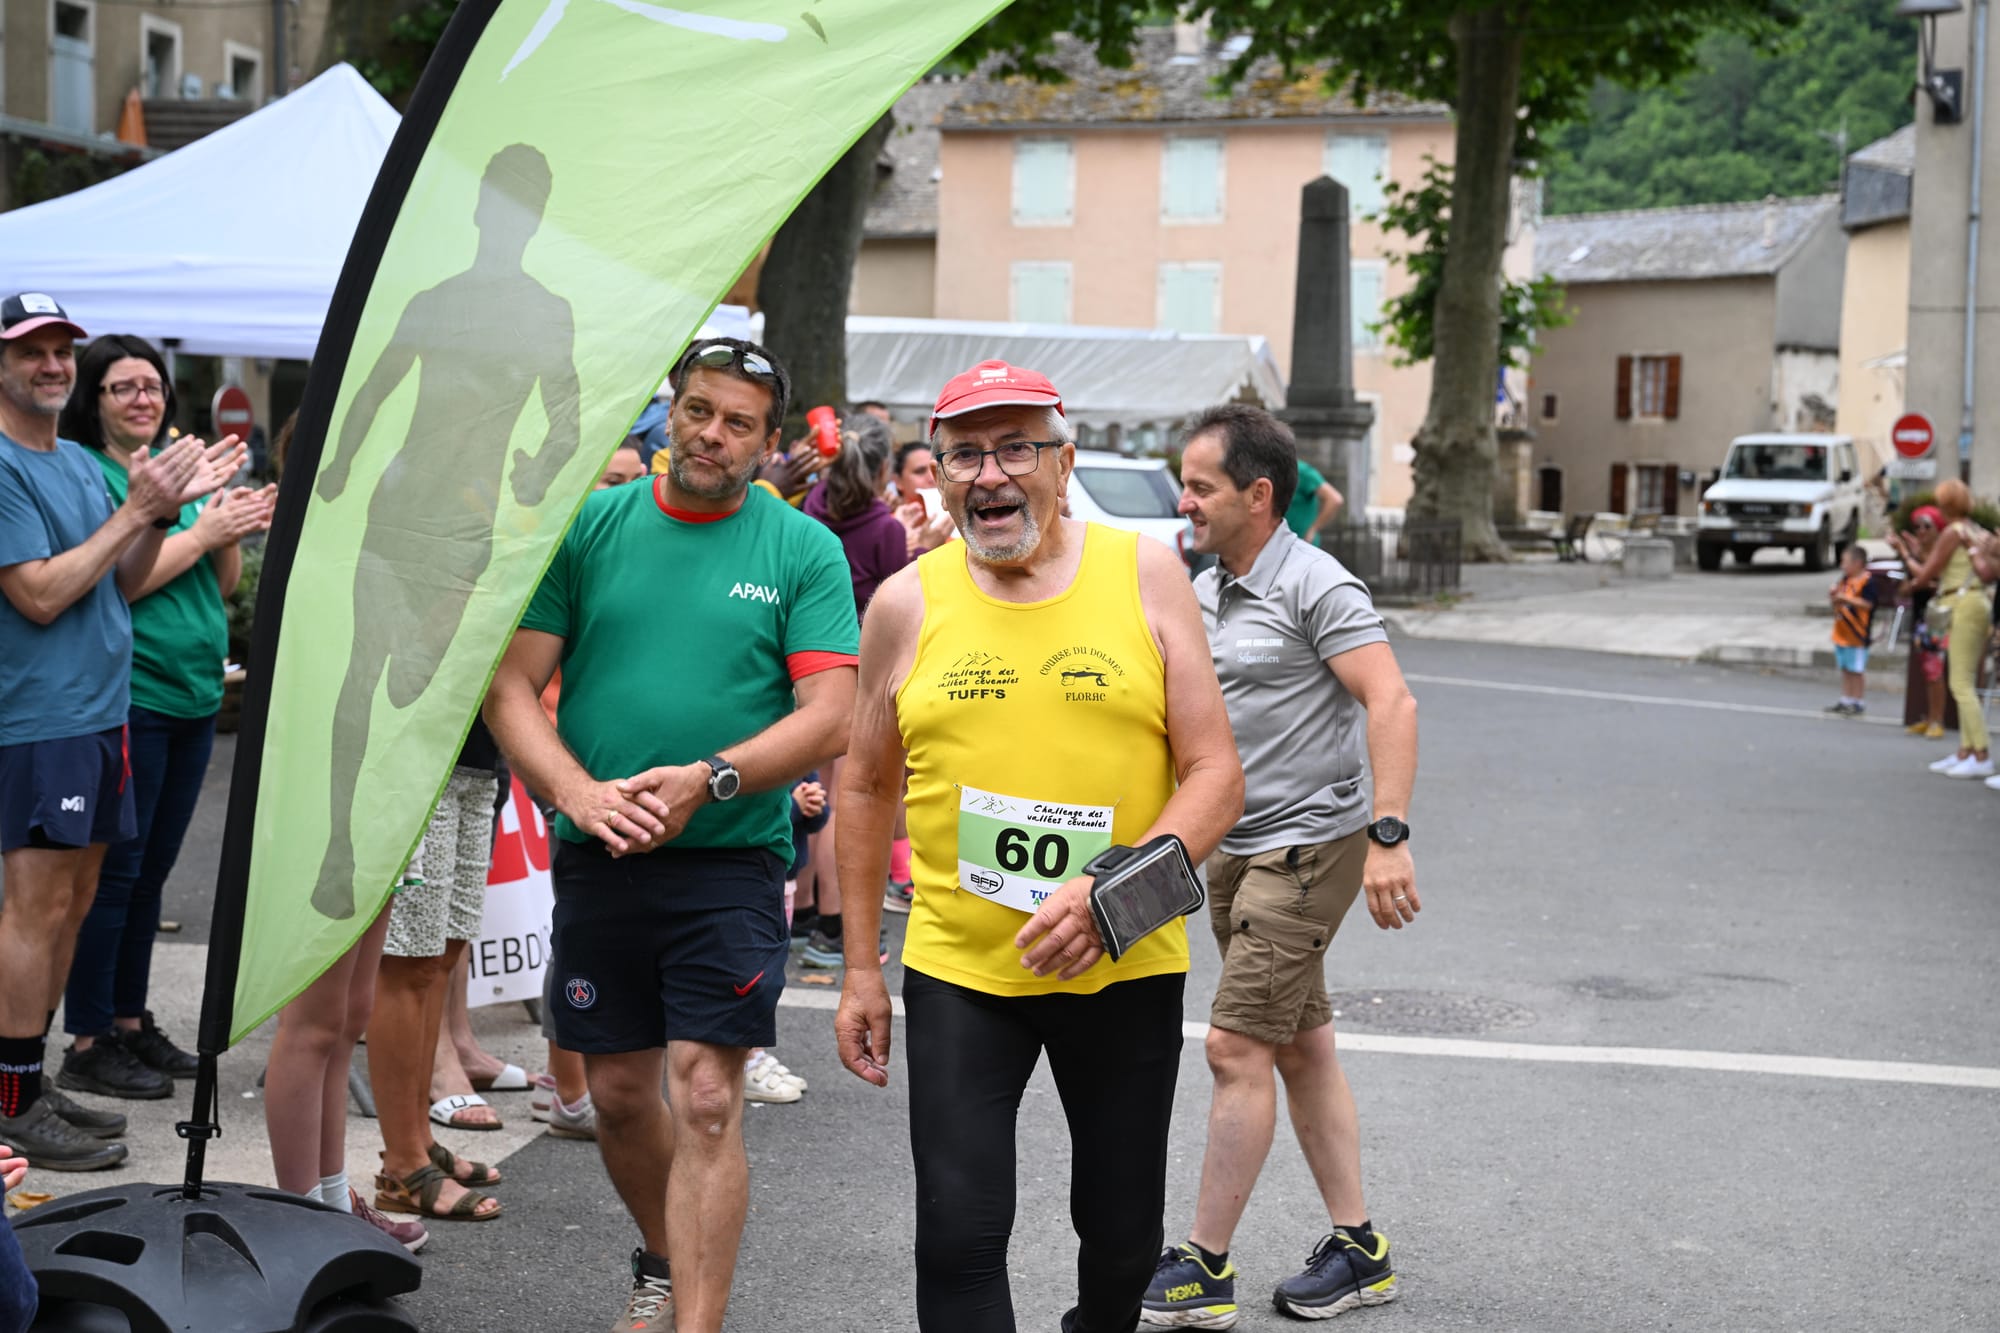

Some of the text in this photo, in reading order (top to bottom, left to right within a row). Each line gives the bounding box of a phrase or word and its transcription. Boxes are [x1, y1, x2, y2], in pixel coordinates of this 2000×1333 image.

[1040, 646, 1125, 677] COURSE DU DOLMEN
[943, 669, 991, 680] Challenge
[938, 677, 1019, 688] vallées cévenoles
[947, 689, 1006, 701] TUFF'S
[1034, 804, 1103, 819] Challenge des
[1027, 814, 1107, 828] vallées cévenoles
[996, 828, 1069, 878] 60
[970, 873, 999, 888] BFP
[1165, 1282, 1204, 1303] HOKA
